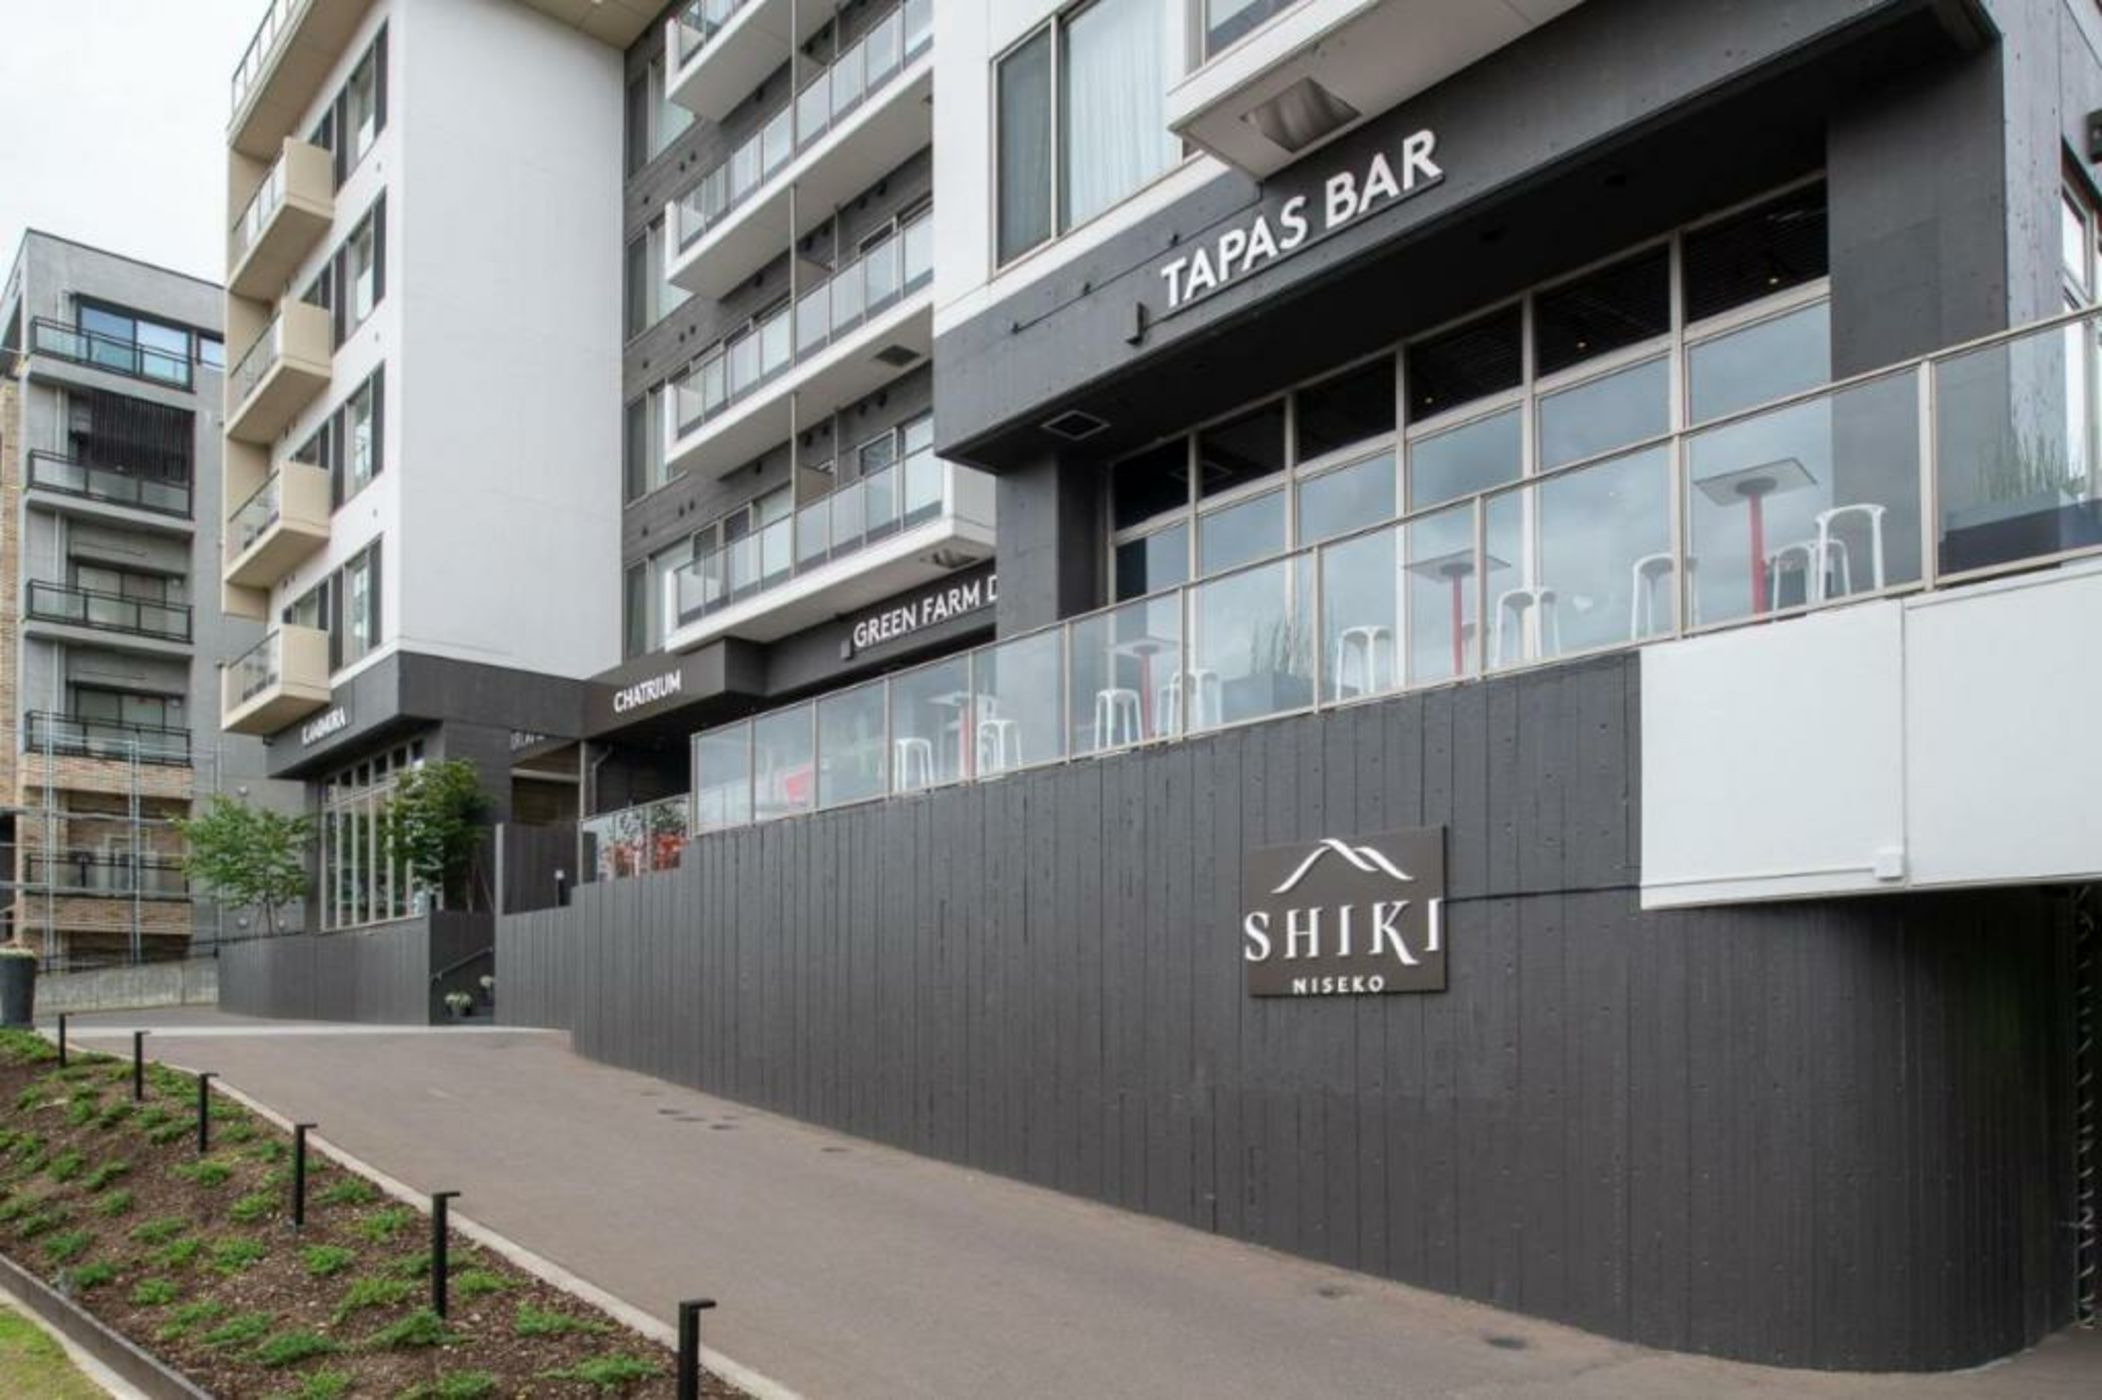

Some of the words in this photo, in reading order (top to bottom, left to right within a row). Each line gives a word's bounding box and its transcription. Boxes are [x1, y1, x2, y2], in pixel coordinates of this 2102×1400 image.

[1160, 195, 1308, 308] TAPAS
[1325, 129, 1443, 229] BAR
[853, 603, 917, 648] GREEN
[921, 579, 981, 625] FARM
[613, 669, 681, 713] CHATRIUM
[1244, 898, 1444, 966] SHIKI
[1292, 975, 1385, 995] NISEKO
